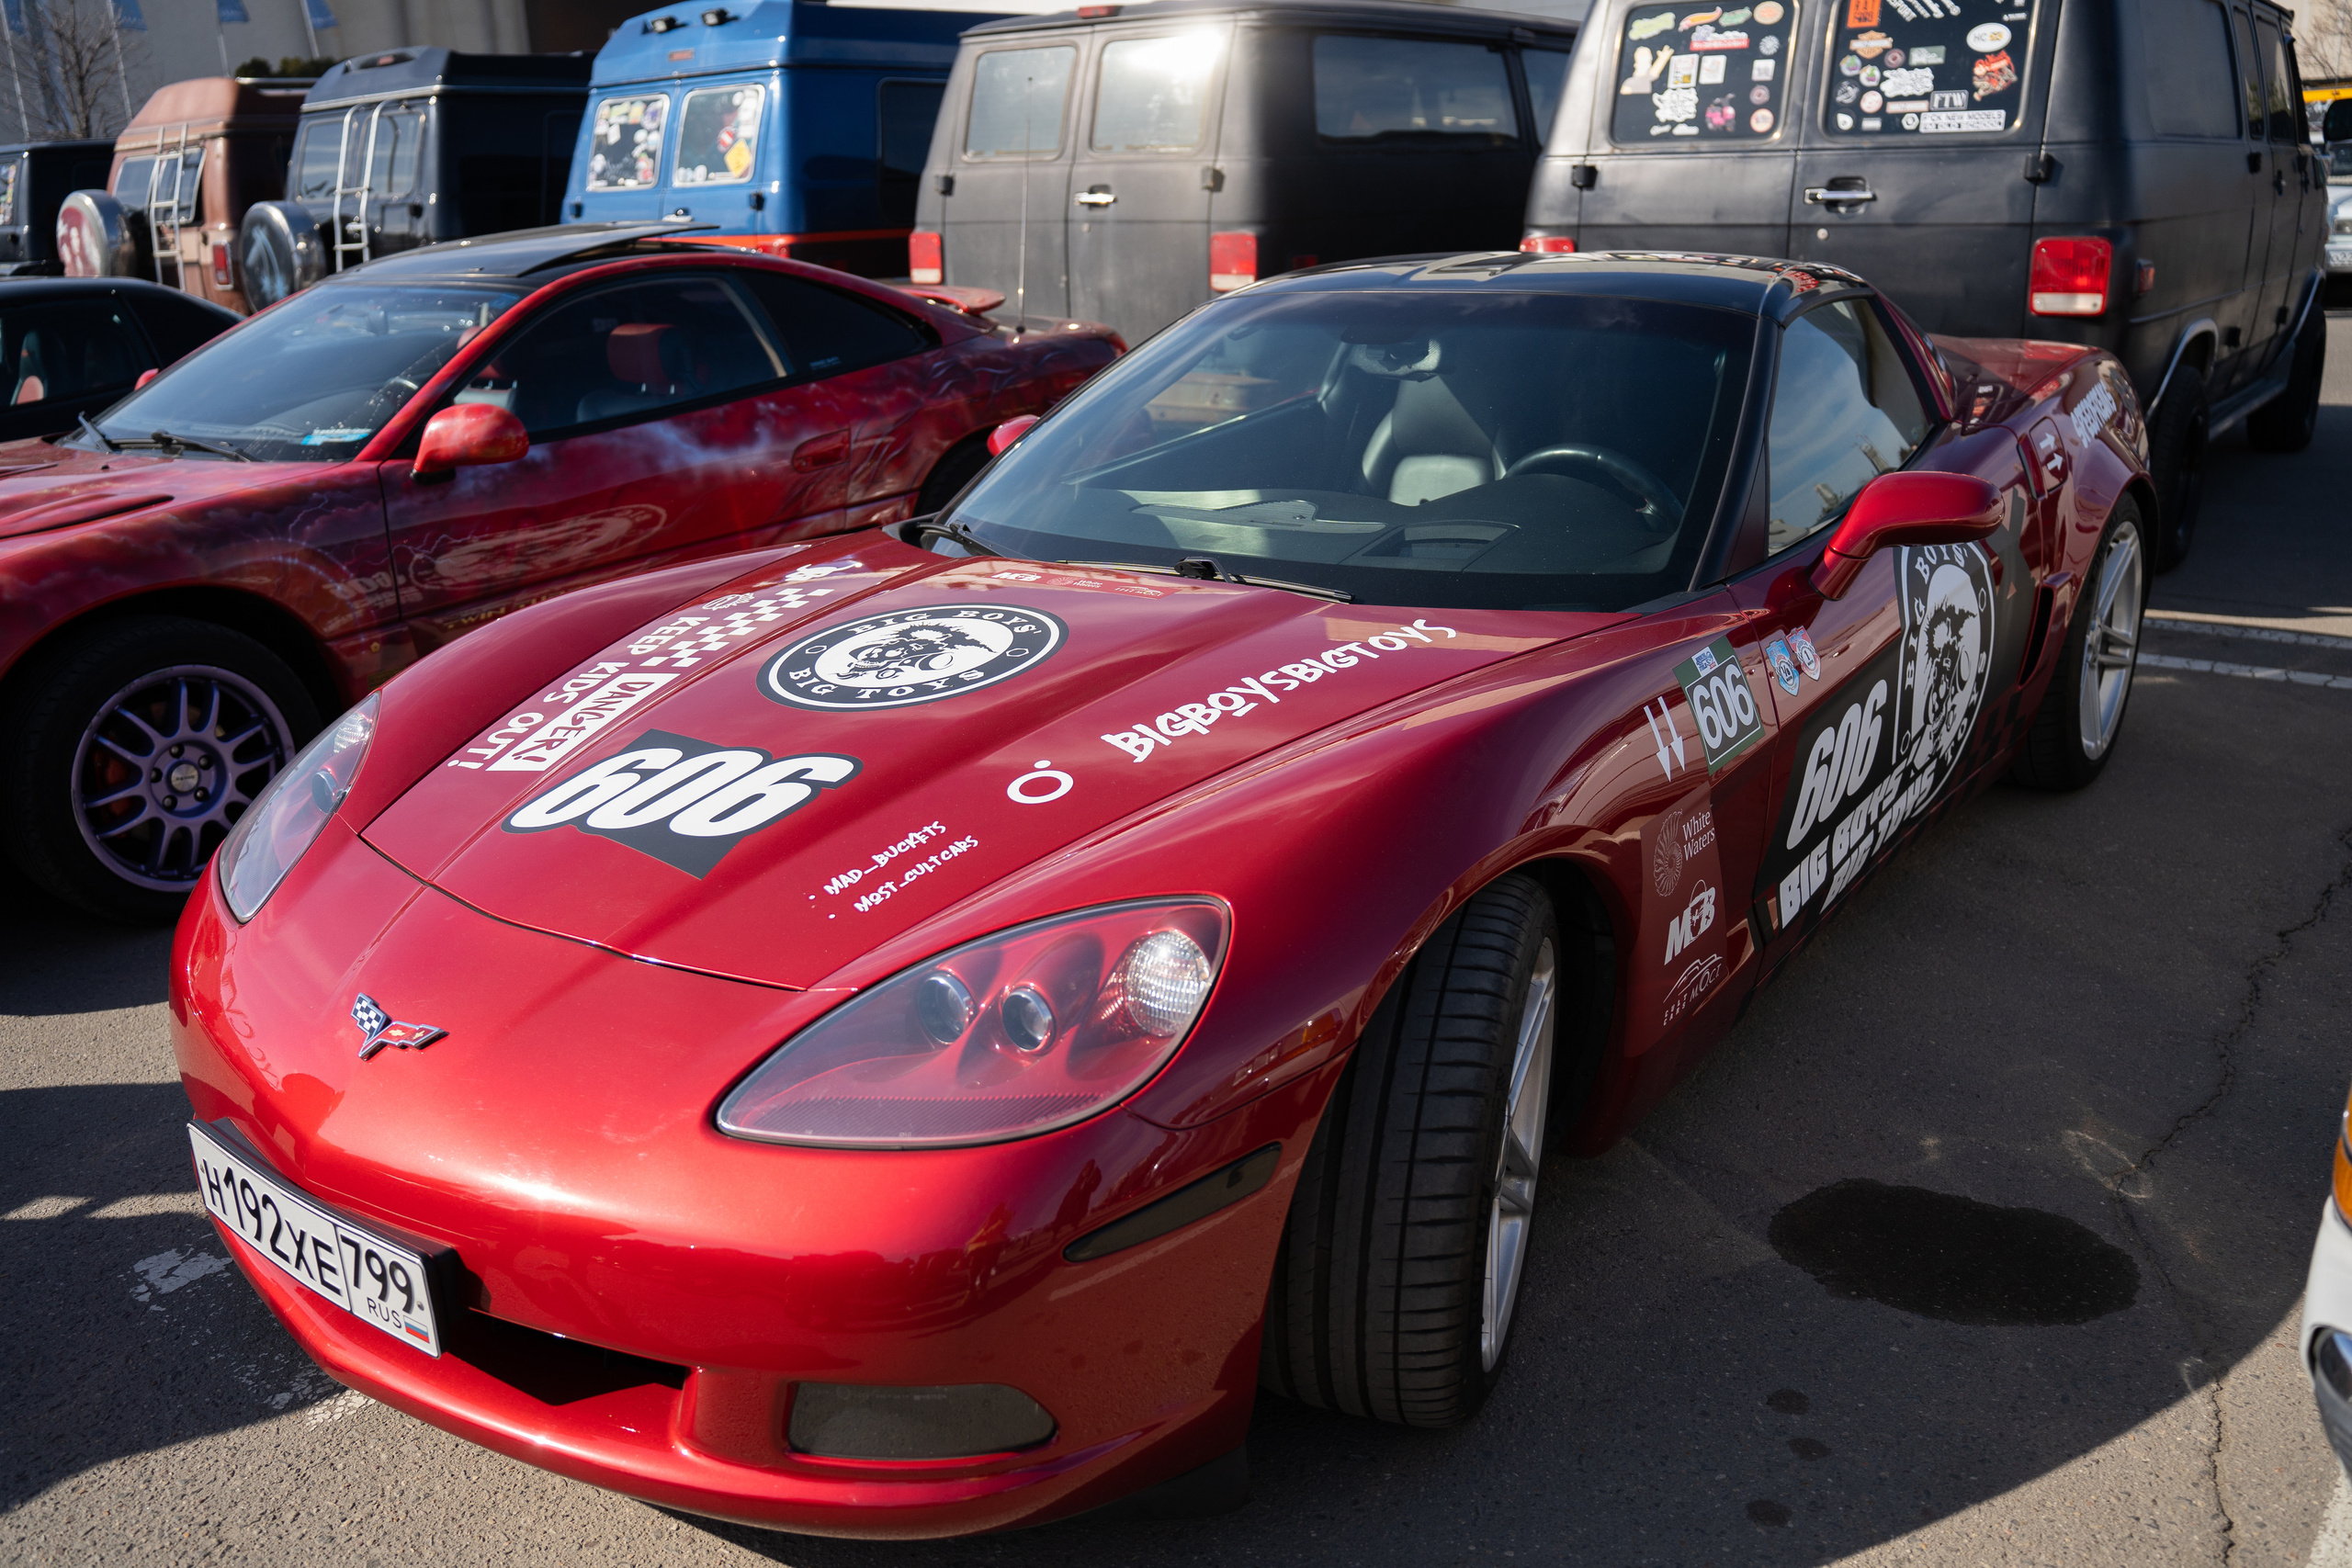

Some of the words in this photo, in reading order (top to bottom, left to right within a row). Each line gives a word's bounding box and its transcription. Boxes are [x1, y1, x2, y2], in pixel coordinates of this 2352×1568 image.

[1933, 92, 1966, 108] FTW
[1968, 111, 2003, 119] MODELS
[626, 615, 710, 656] KEEP
[848, 612, 933, 635] BIG
[1905, 597, 1927, 691] BIG
[543, 660, 630, 705] KIDS
[788, 666, 840, 695] BIG
[855, 669, 985, 698] TOYS
[1101, 618, 1457, 763] BIGBOYSBIGTOYS
[1692, 663, 1755, 750] 606
[447, 712, 545, 771] OUT!
[514, 681, 655, 762] DANGER!
[509, 747, 855, 838] 606
[1786, 679, 1887, 851] 606
[823, 820, 947, 896] MAD_BUCKETS
[1682, 810, 1712, 842] White
[1683, 827, 1716, 862] Waters
[1819, 829, 1874, 915] BIG
[1871, 758, 1938, 858] TOYS
[1779, 834, 1830, 930] BIG
[202, 1158, 344, 1297] H192XE
[340, 1234, 413, 1314] 799
[367, 1297, 403, 1329] RUS
